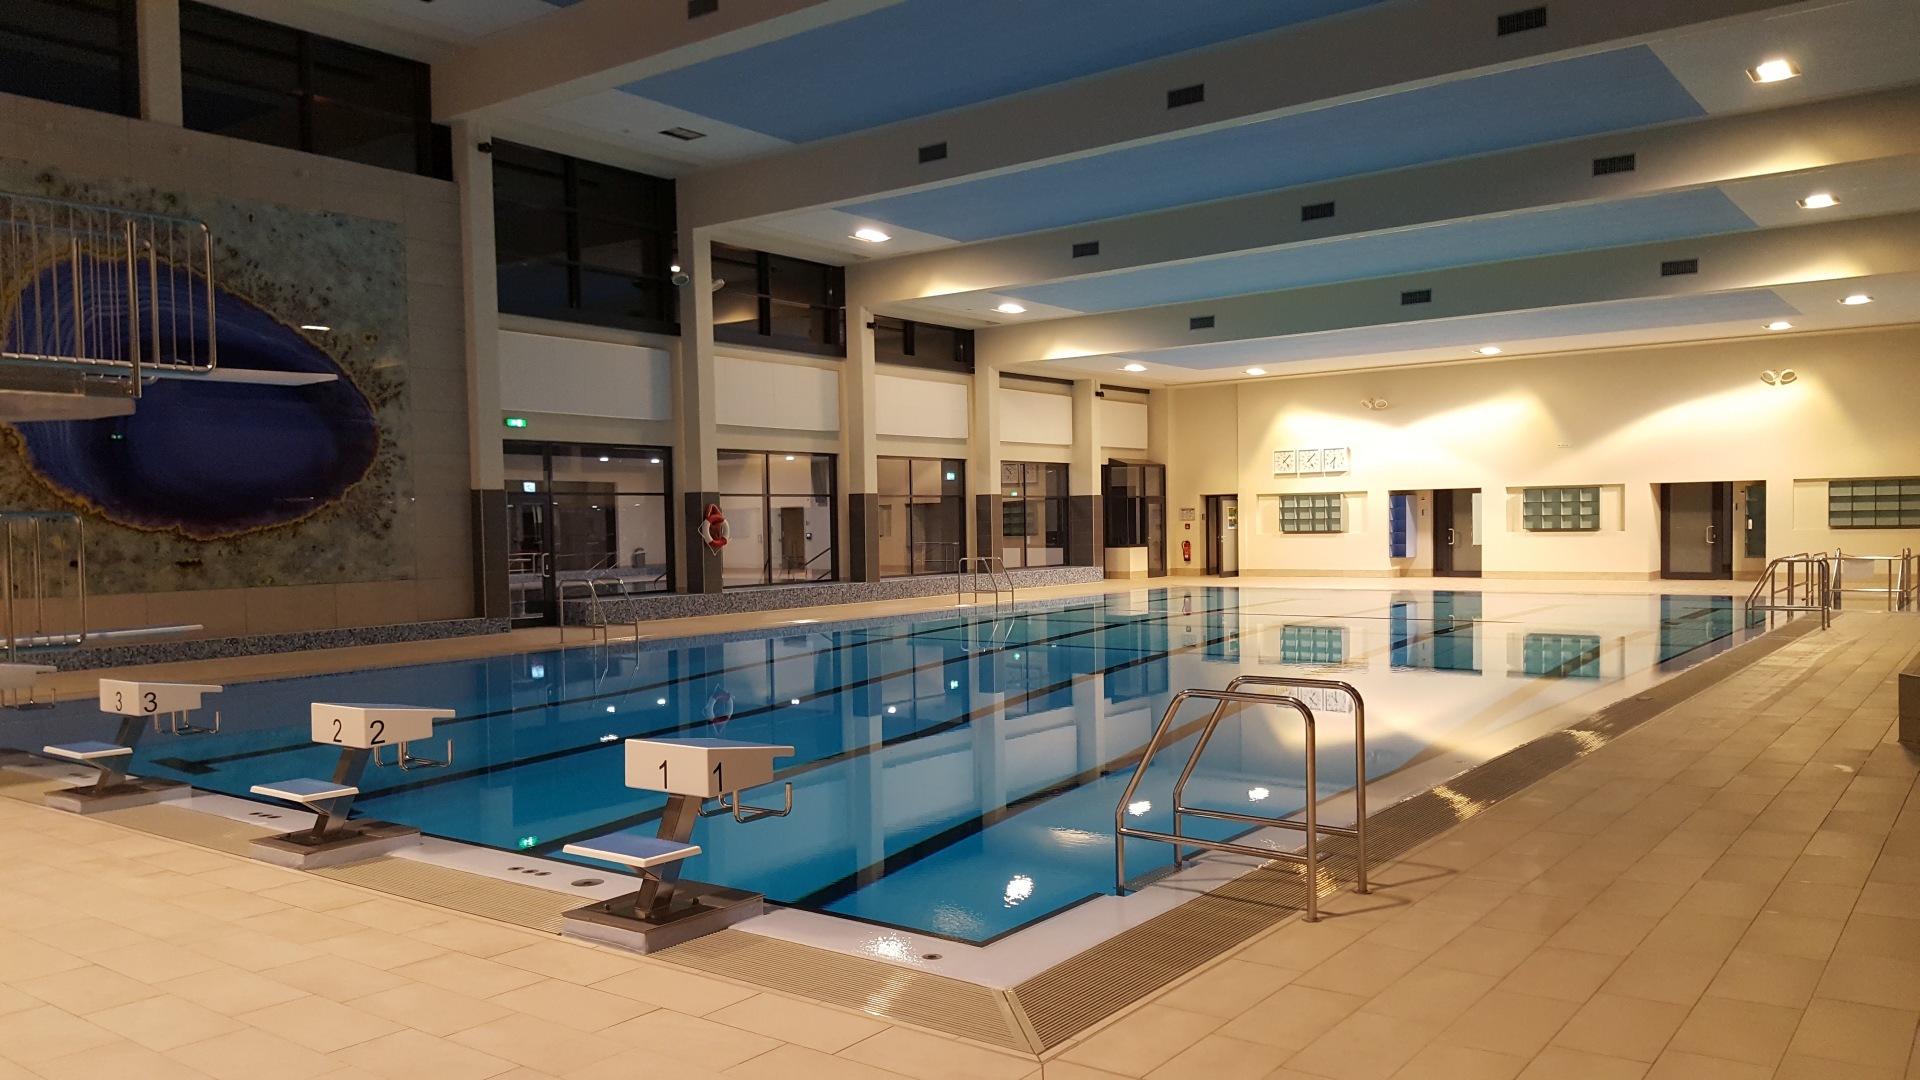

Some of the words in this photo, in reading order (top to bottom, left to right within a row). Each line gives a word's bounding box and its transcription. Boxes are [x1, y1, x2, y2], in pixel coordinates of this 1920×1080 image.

[115, 691, 123, 712] 3
[143, 691, 158, 713] 3
[332, 718, 343, 744] 2
[369, 719, 386, 746] 2
[658, 759, 668, 790] 1
[712, 761, 723, 793] 1
